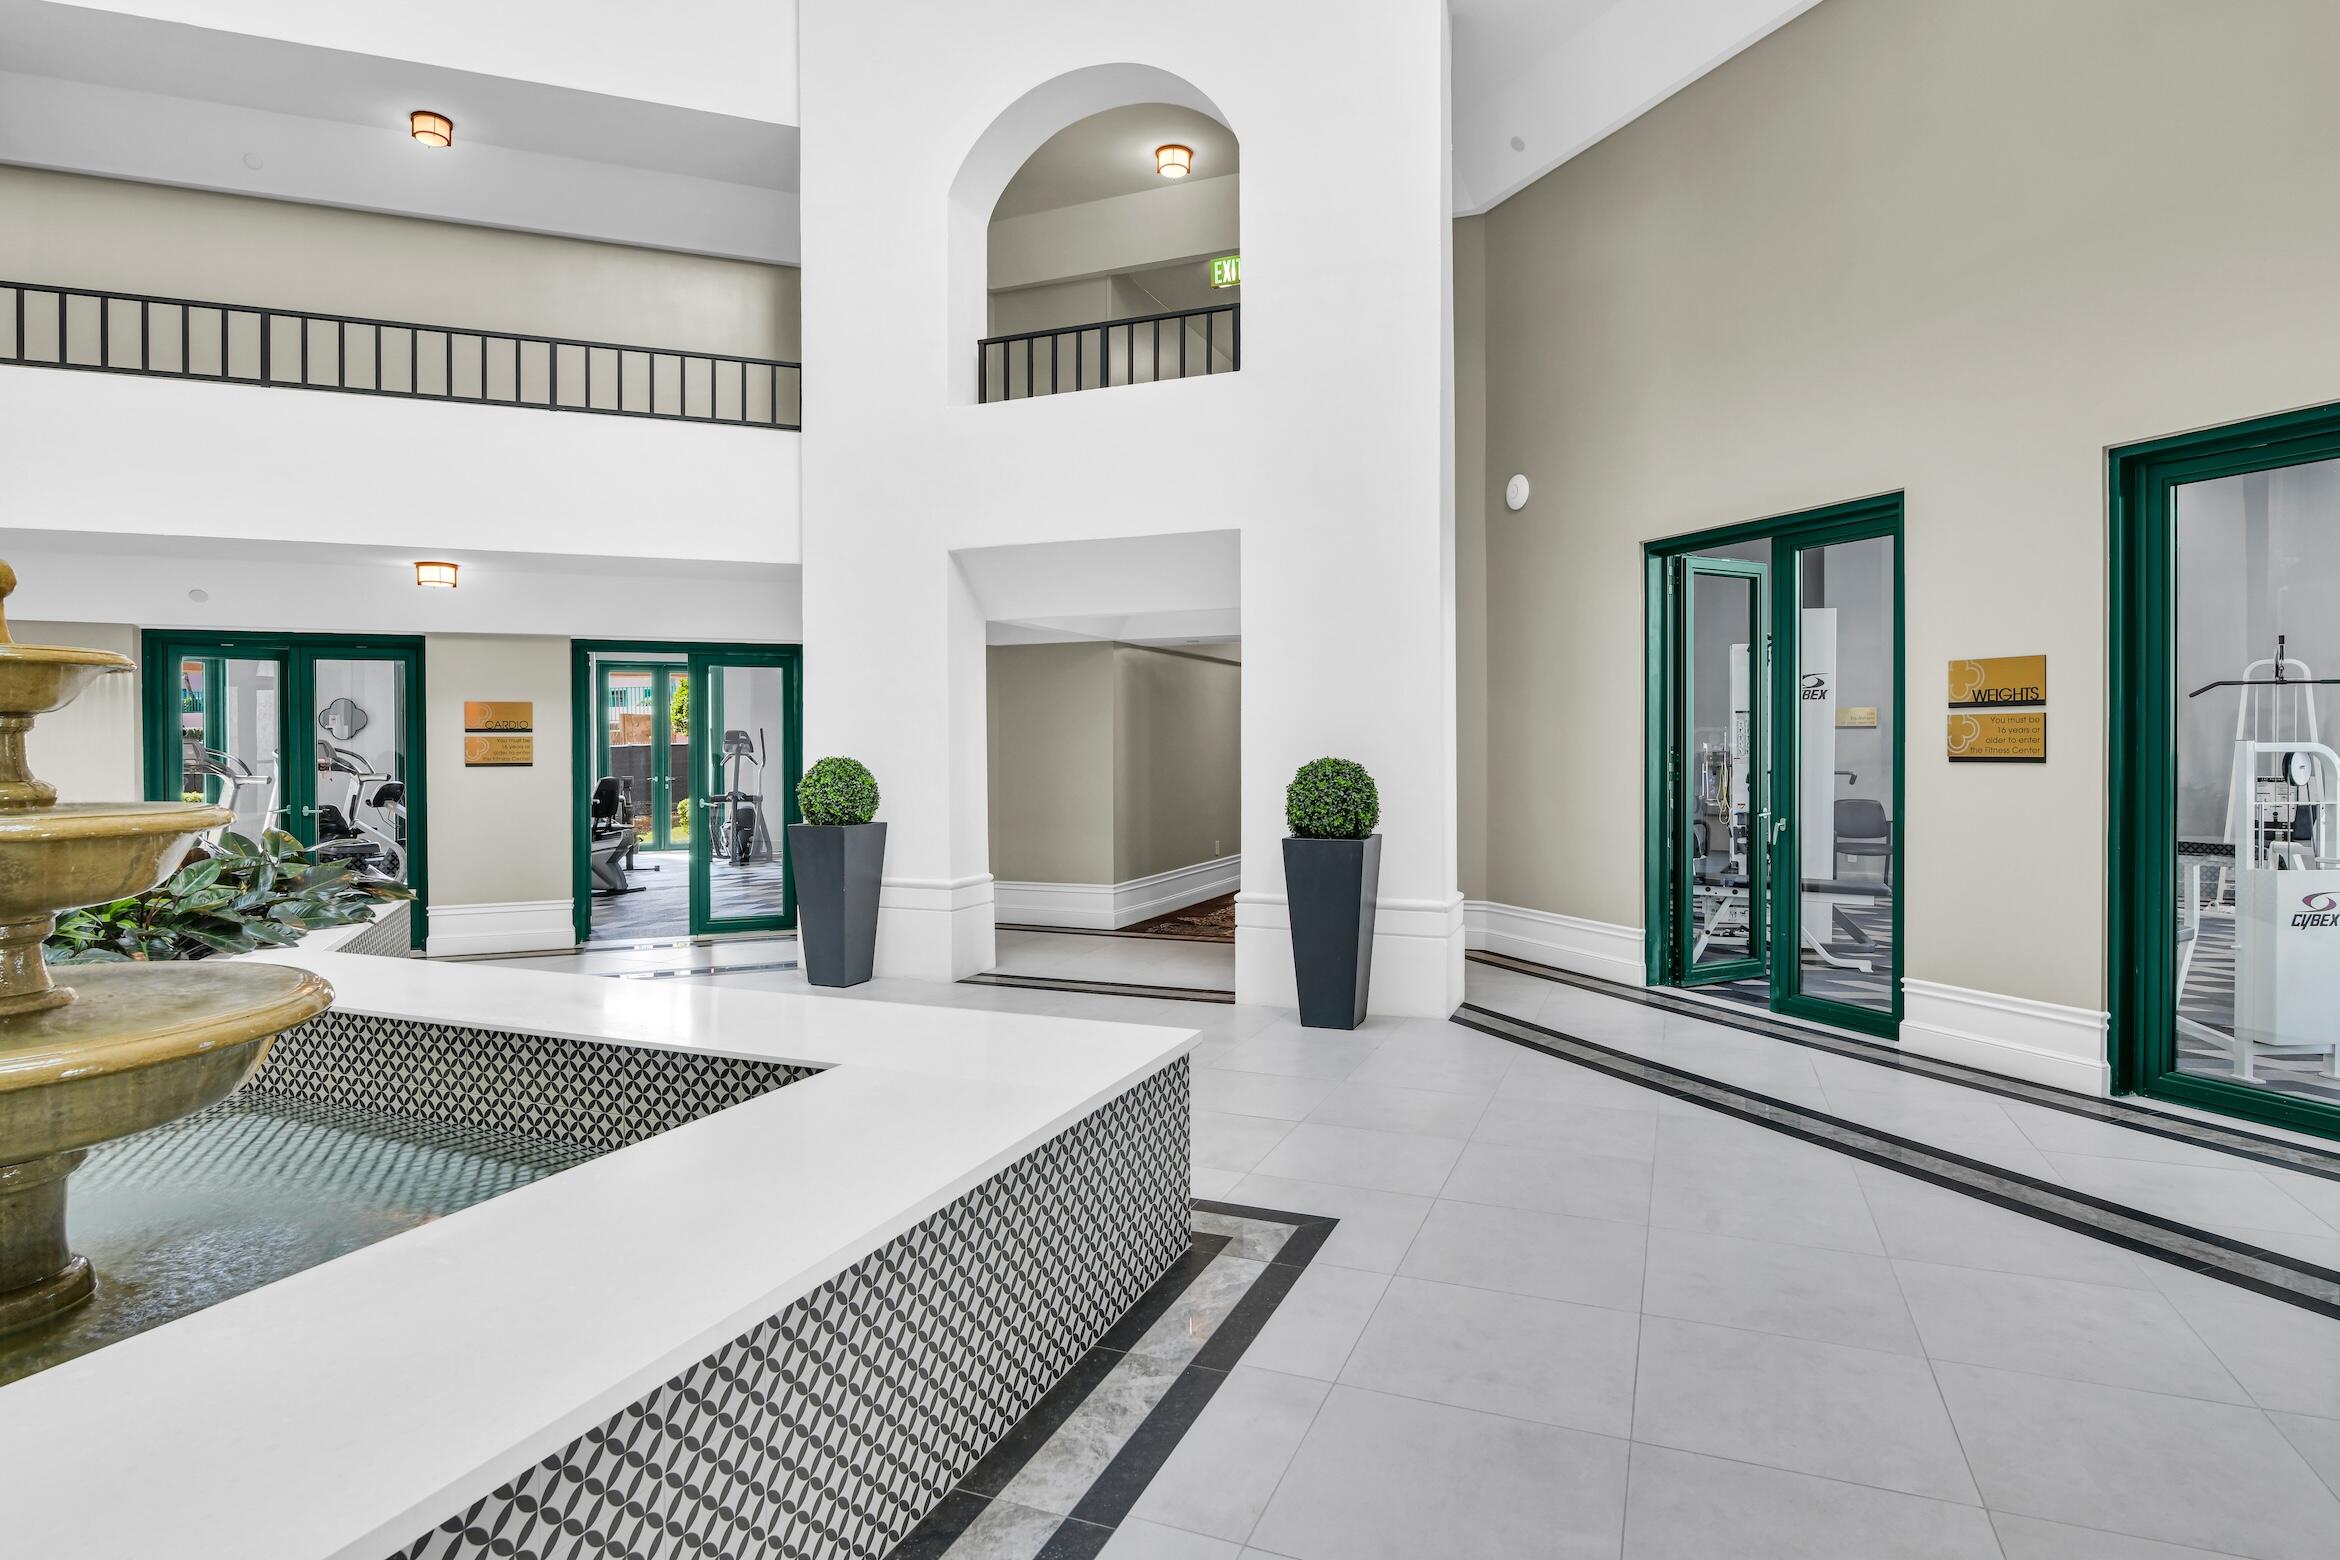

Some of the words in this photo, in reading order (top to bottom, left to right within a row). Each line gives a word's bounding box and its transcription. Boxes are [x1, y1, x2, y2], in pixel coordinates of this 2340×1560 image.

[1802, 689, 1828, 700] BEX
[1972, 686, 2039, 702] WEIGHTS
[485, 720, 529, 729] CARDIO
[1990, 716, 2006, 724] You
[2008, 716, 2026, 724] must
[2029, 715, 2040, 723] be
[1998, 726, 2006, 734] 16
[2008, 727, 2030, 735] years
[2291, 914, 2340, 930] CYBEX
